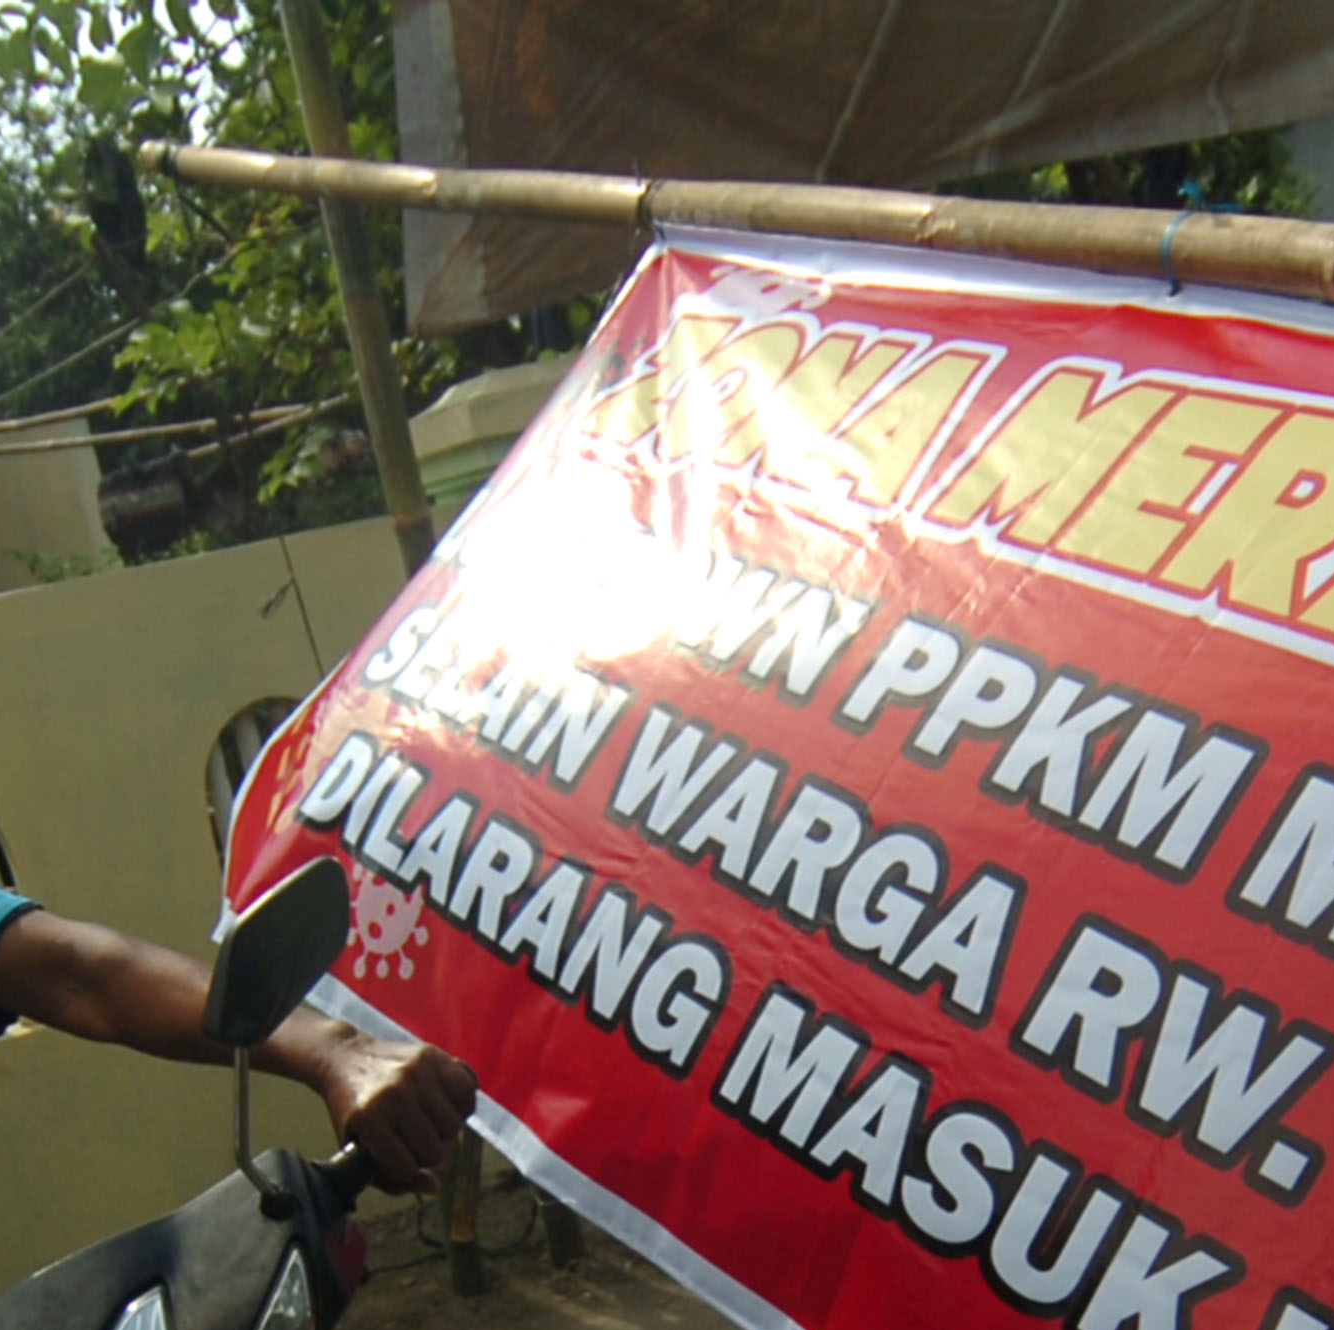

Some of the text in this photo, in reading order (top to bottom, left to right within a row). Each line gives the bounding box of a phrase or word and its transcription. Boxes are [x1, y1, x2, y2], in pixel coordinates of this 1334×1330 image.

[299, 734, 727, 1069] DILARANG
[363, 603, 635, 785] SELAIN
[612, 706, 1025, 1014] WARGA
[1018, 926, 1328, 1192] RW.
[840, 616, 1259, 872] PPKM
